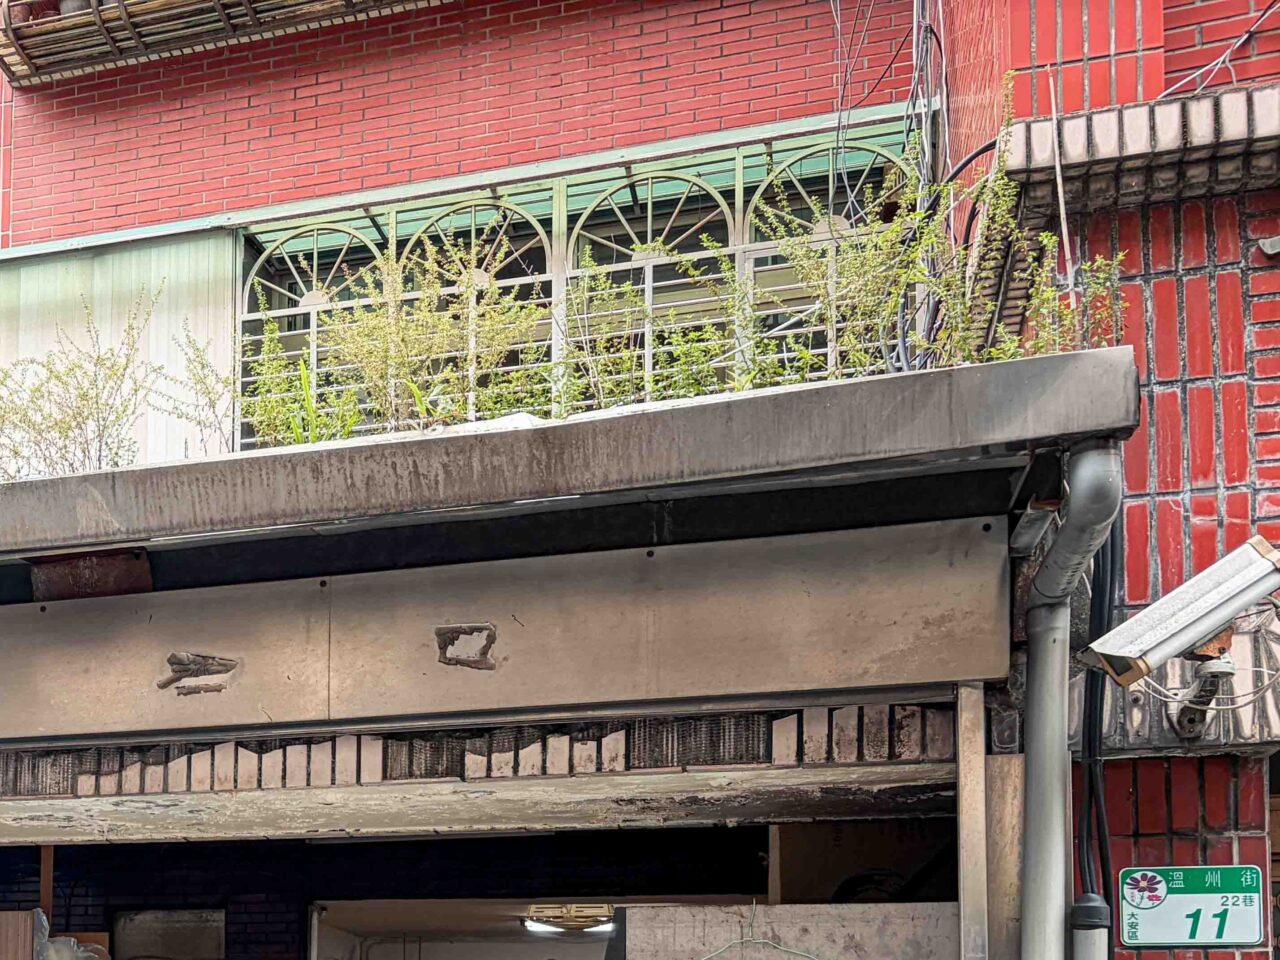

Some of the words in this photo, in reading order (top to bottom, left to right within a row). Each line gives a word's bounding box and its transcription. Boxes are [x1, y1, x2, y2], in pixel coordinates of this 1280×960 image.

[1168, 869, 1257, 888] 溫州街
[1220, 895, 1256, 907] 22巷
[1127, 912, 1139, 940] 大安區
[1185, 908, 1230, 940] 11
